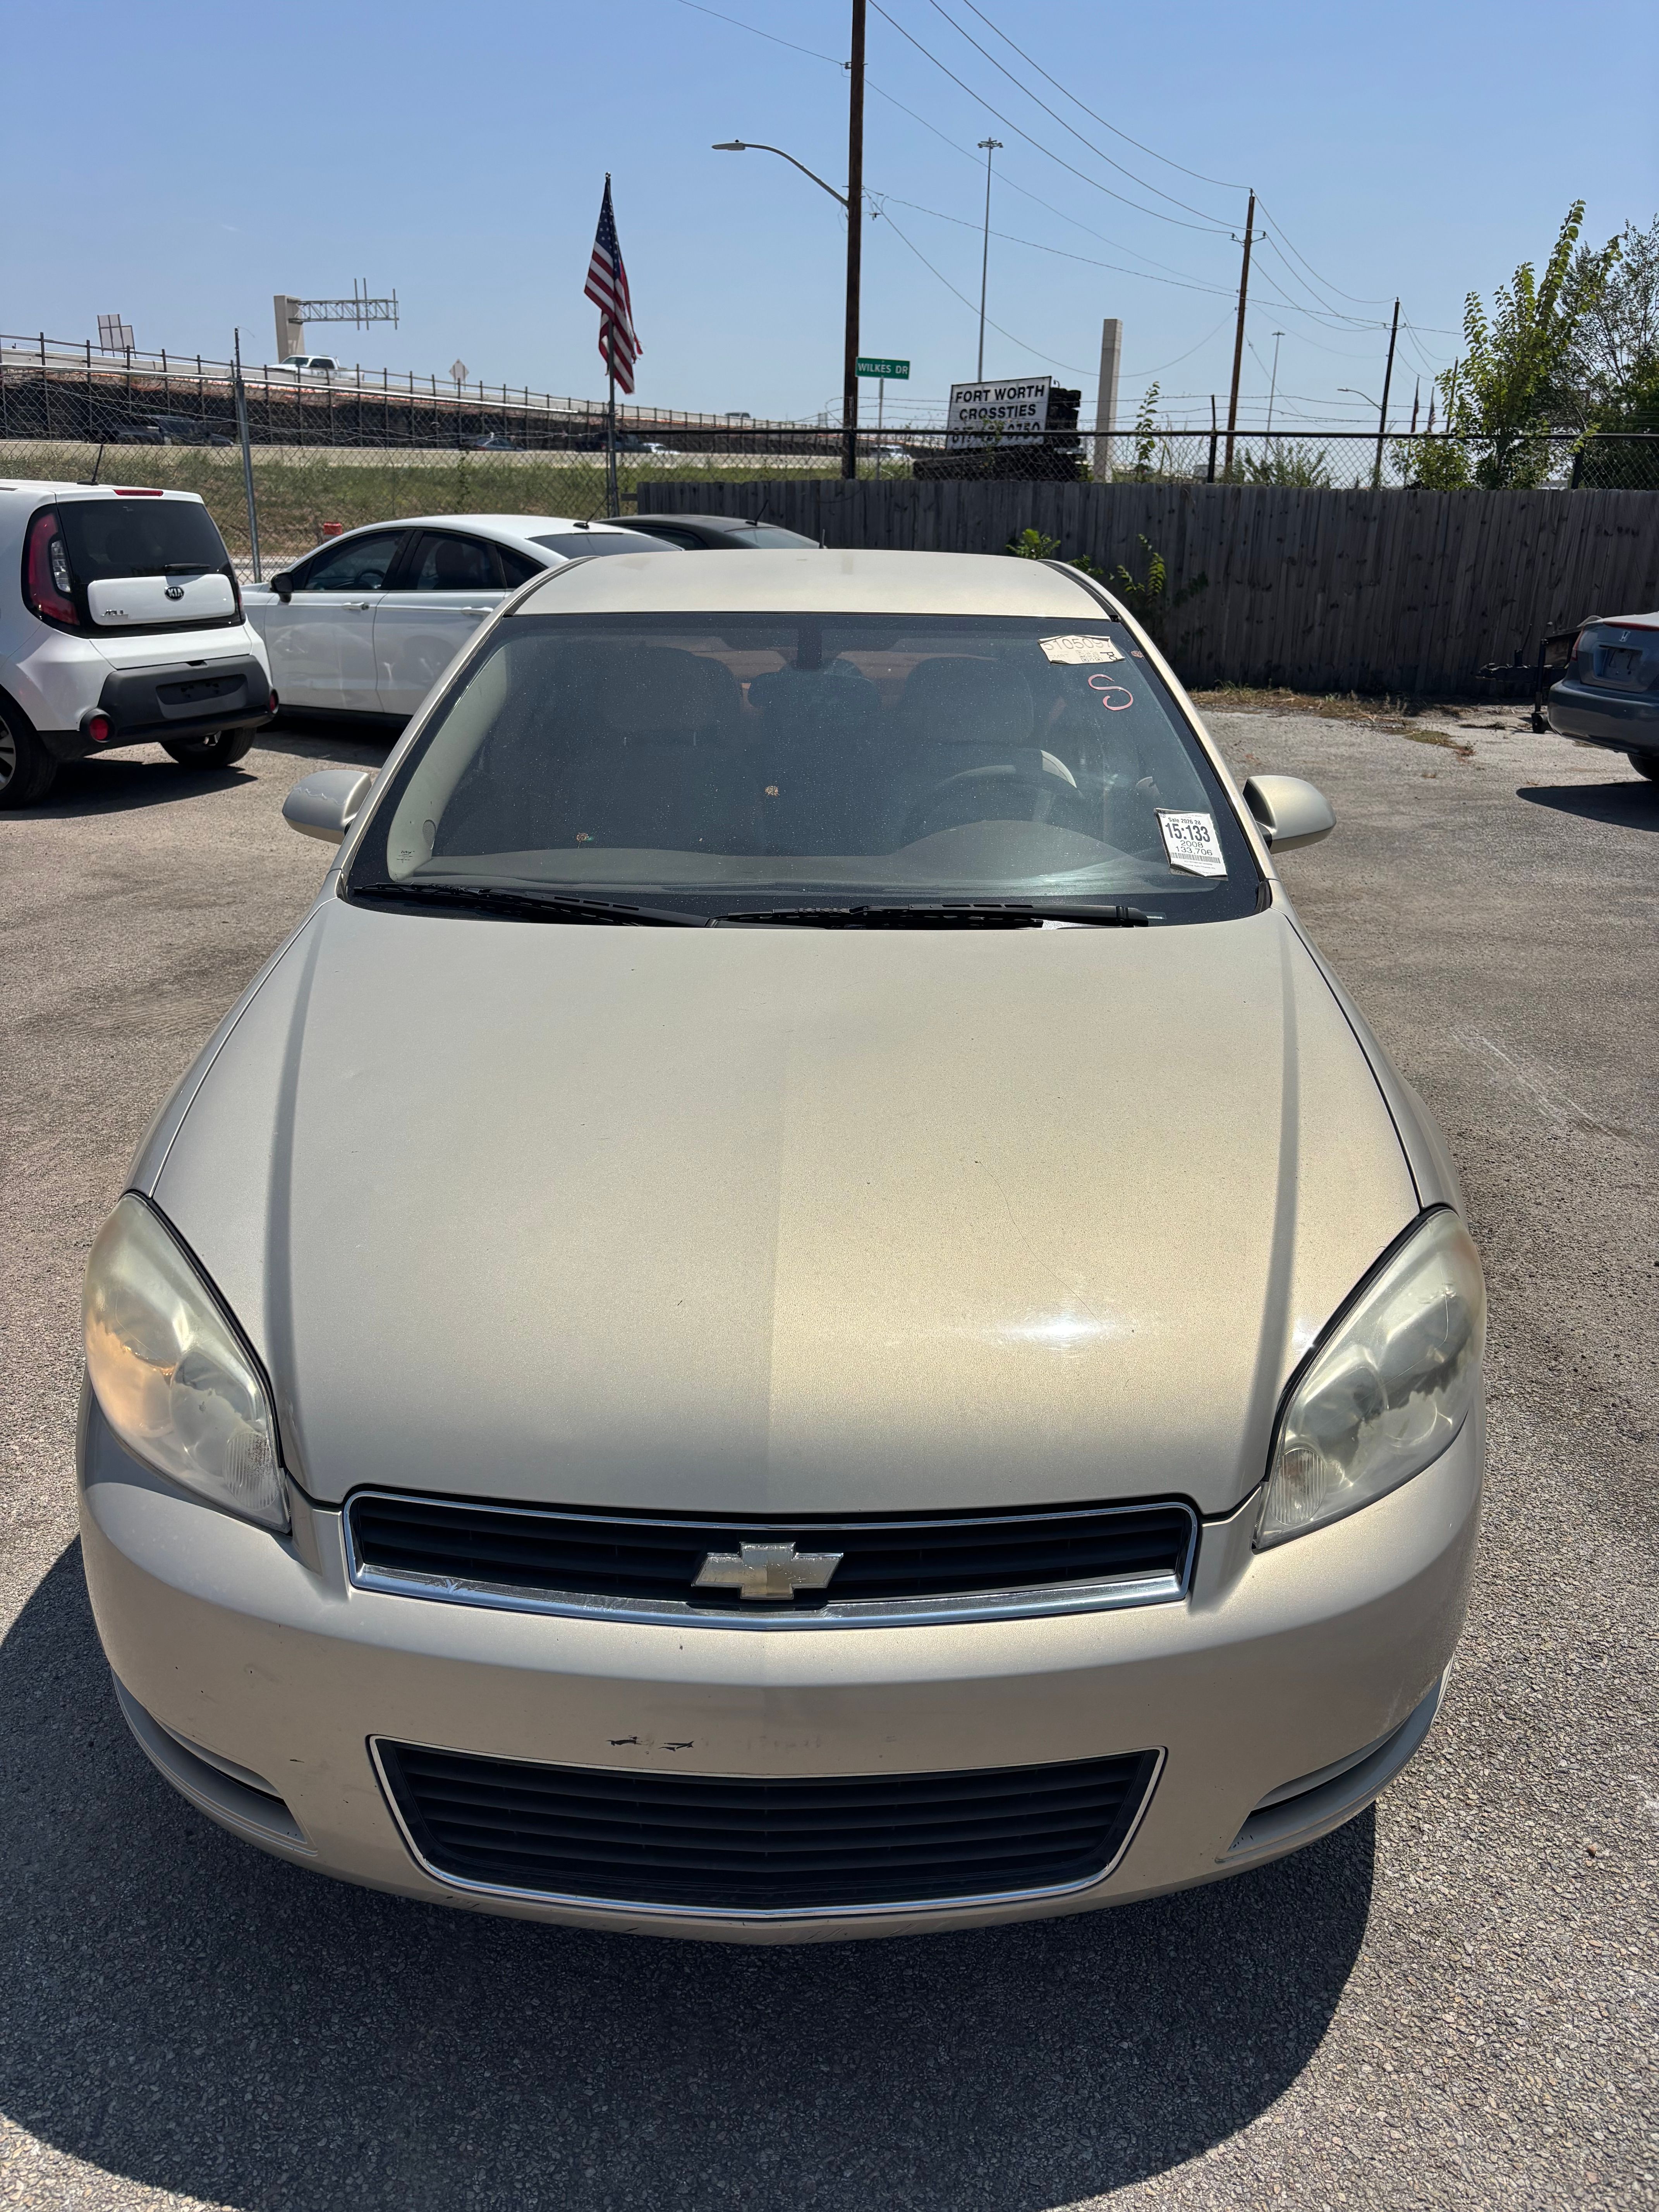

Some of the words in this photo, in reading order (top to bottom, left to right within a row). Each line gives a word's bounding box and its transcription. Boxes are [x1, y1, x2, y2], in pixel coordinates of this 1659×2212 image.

[858, 363, 891, 373] WILKES
[895, 365, 908, 374] DR
[955, 389, 991, 403] FORT
[994, 385, 1045, 401] WORTH
[960, 404, 1037, 421] CROSSTIES
[168, 588, 182, 597] KIA
[1088, 674, 1133, 711] S
[1165, 823, 1210, 842] 15:133
[1180, 840, 1203, 848] 2008
